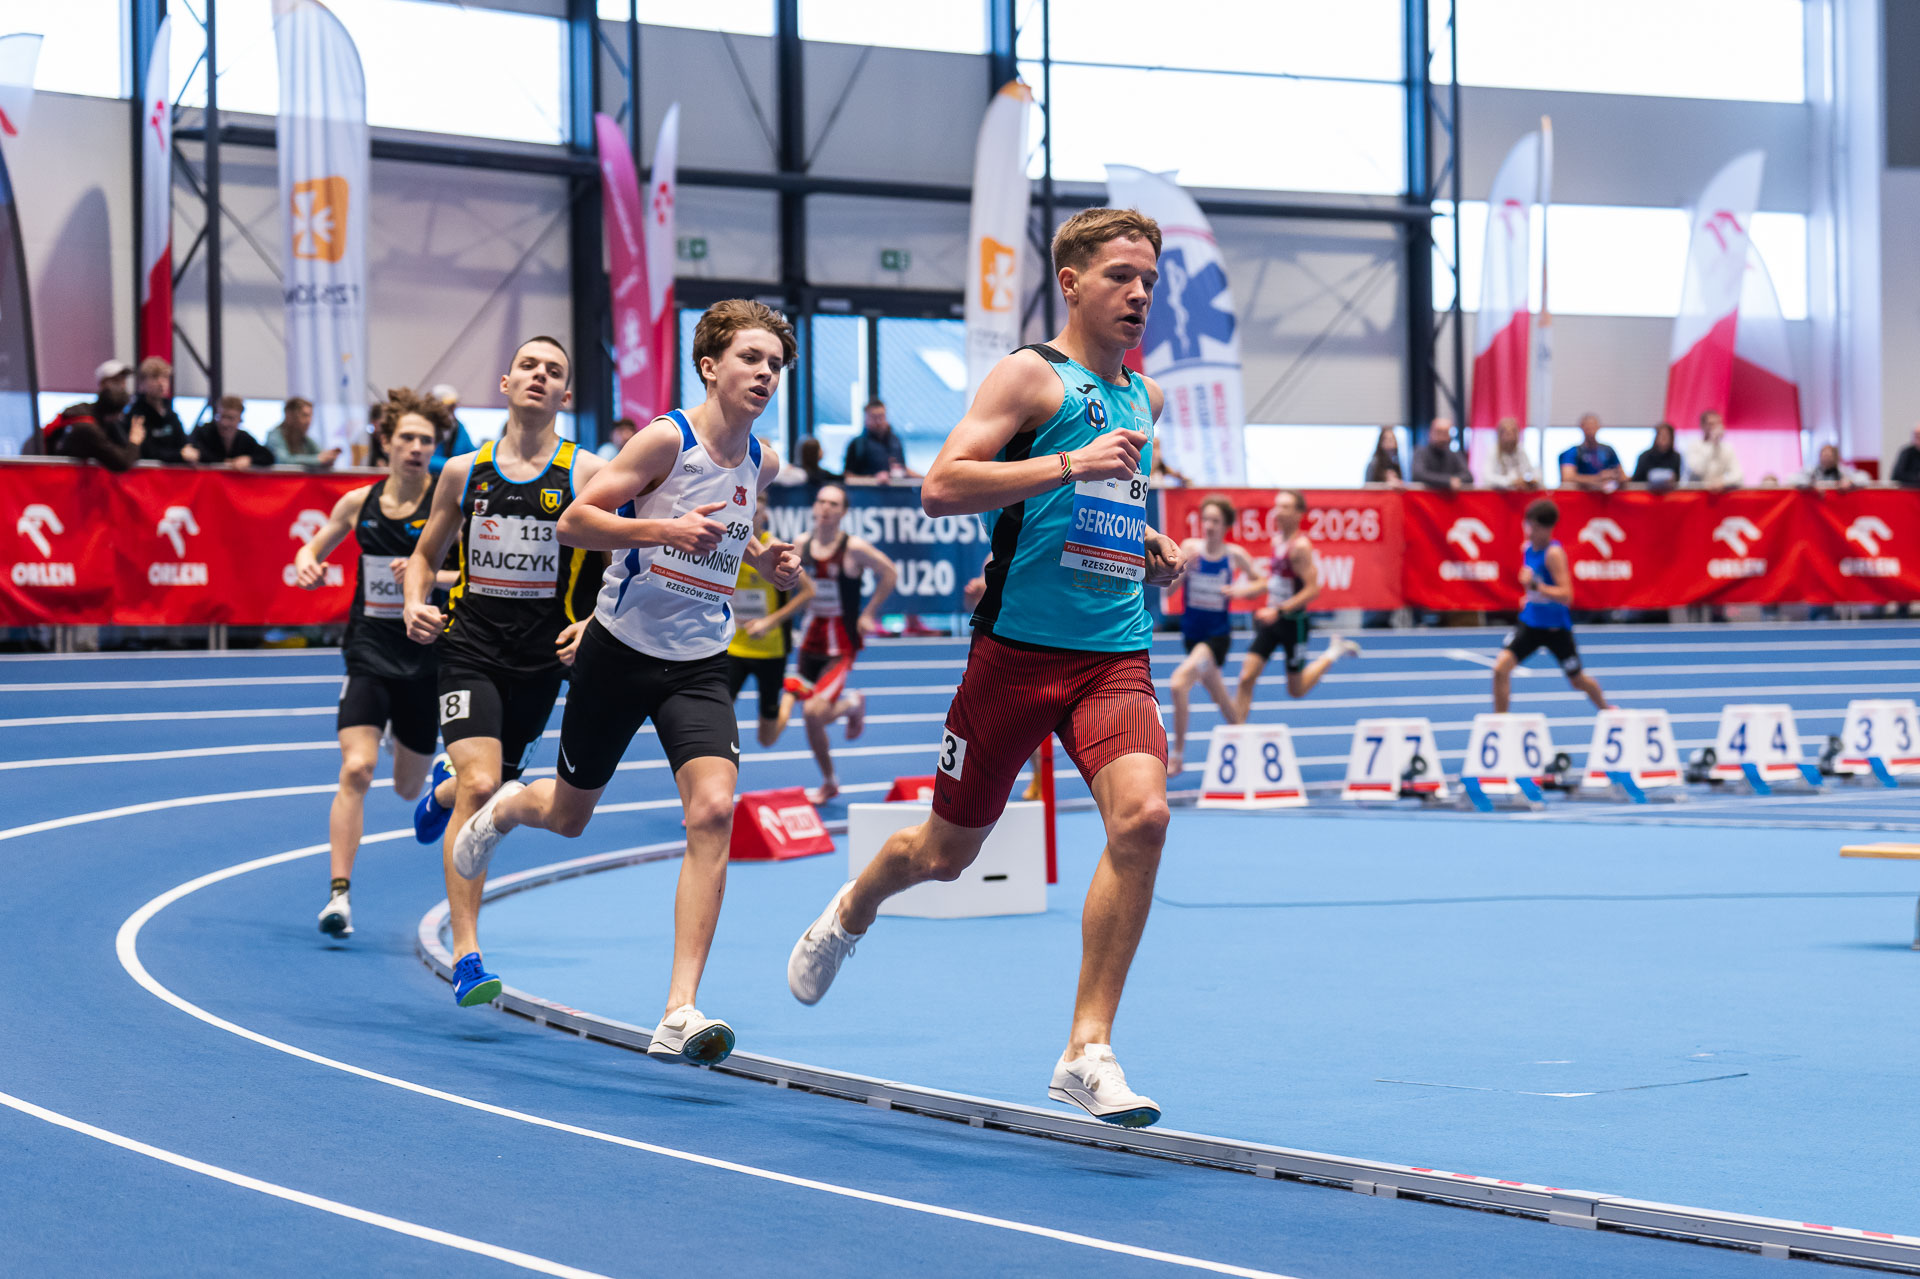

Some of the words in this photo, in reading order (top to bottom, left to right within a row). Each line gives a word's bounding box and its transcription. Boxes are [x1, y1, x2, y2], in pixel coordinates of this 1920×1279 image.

[520, 525, 553, 542] 113
[726, 521, 750, 541] 458
[11, 563, 76, 586] ORLEN
[149, 563, 208, 586] ORLEN
[471, 549, 556, 572] RAJCZYK
[895, 559, 955, 596] U20
[1081, 558, 1125, 575] RZESZÓW
[1125, 566, 1138, 577] 2026
[481, 586, 518, 597] RZESZÓW
[665, 580, 704, 598] RZESZÓW
[445, 693, 461, 717] 8
[1481, 731, 1499, 769] 6
[1522, 731, 1541, 769] 6
[1604, 726, 1623, 765] 5
[1646, 725, 1664, 764] 5
[1728, 721, 1748, 757] 4
[1771, 721, 1788, 756] 4
[1854, 717, 1873, 753] 3
[1894, 716, 1913, 752] 3
[941, 734, 957, 771] 3
[1218, 743, 1237, 784] 8
[1262, 742, 1283, 783] 8
[1365, 736, 1384, 776] 7
